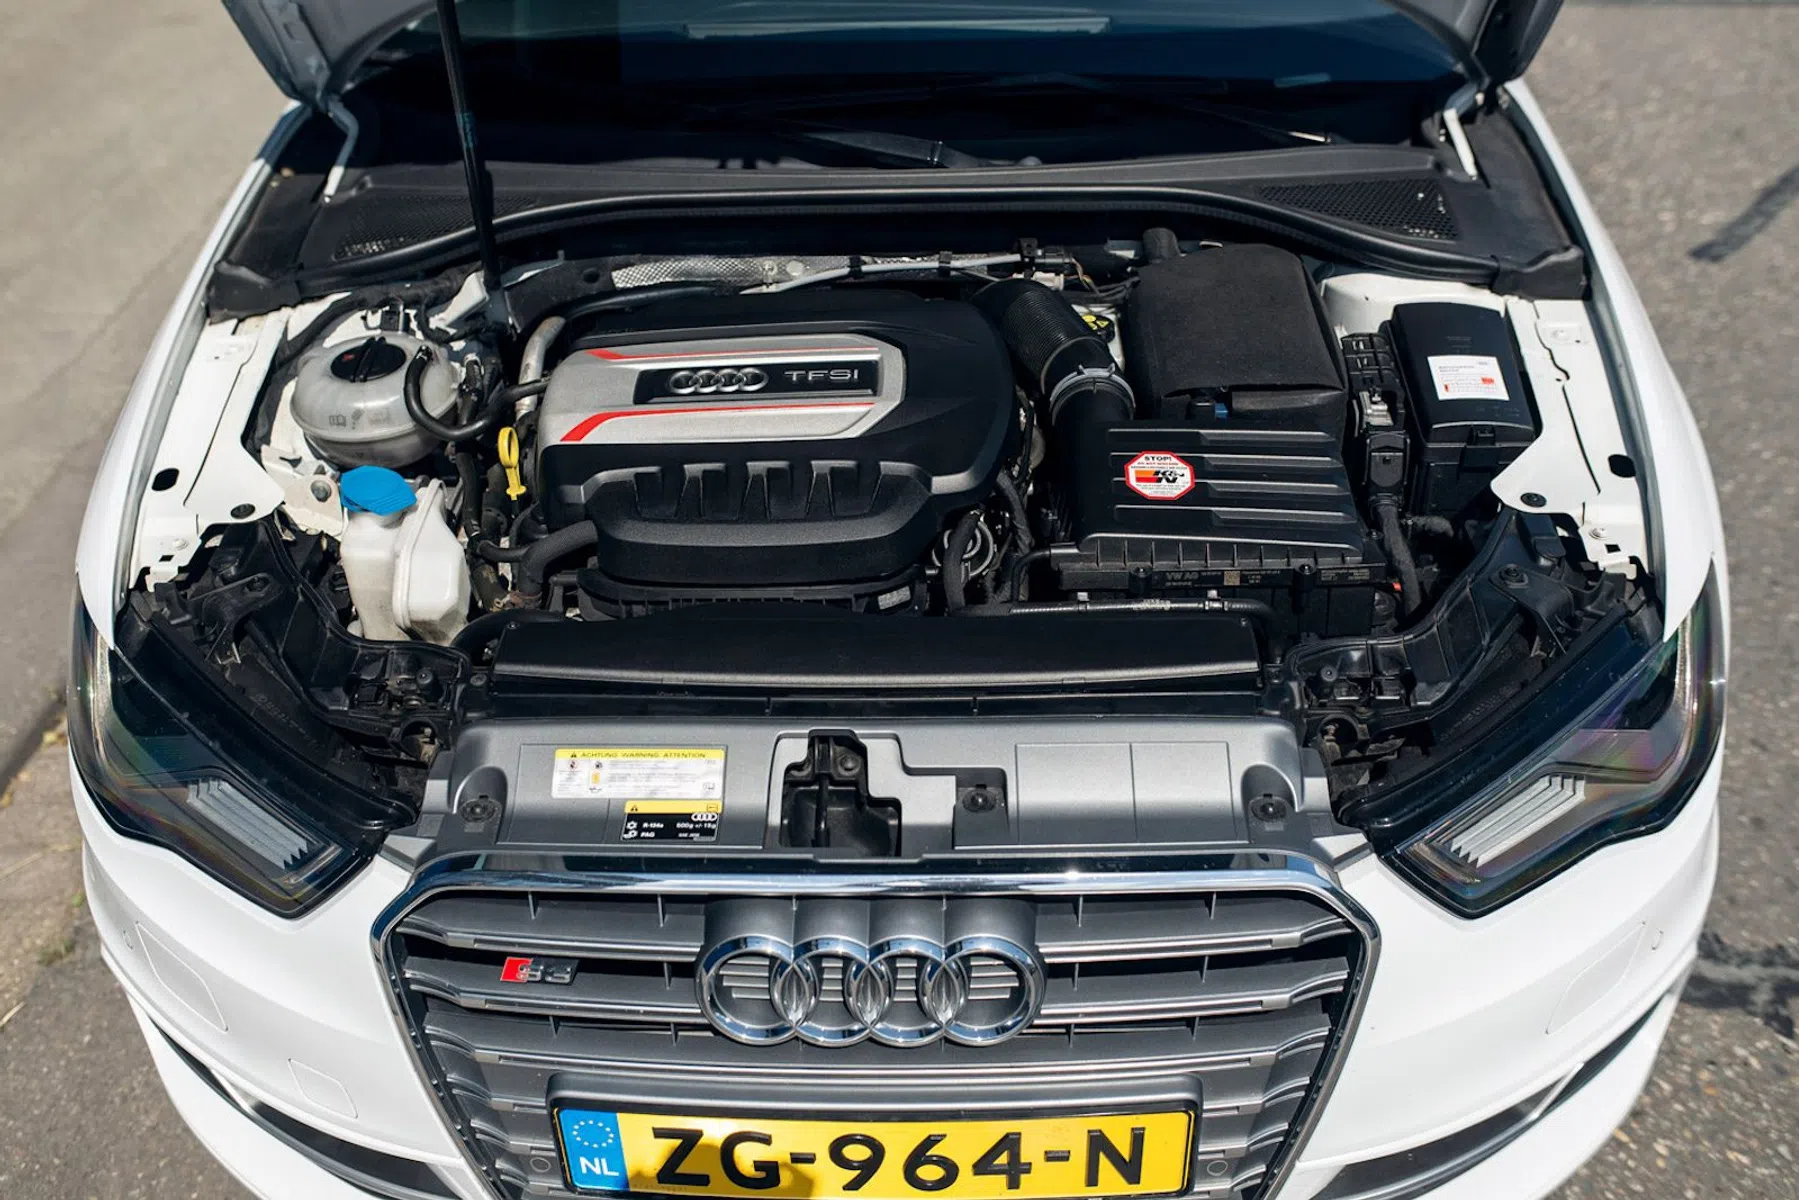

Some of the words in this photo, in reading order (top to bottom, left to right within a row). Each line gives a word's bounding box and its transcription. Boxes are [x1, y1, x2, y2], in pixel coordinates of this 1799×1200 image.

[784, 369, 860, 382] TFSI
[579, 1156, 619, 1177] NL
[652, 1126, 1146, 1191] ZG-964-N
